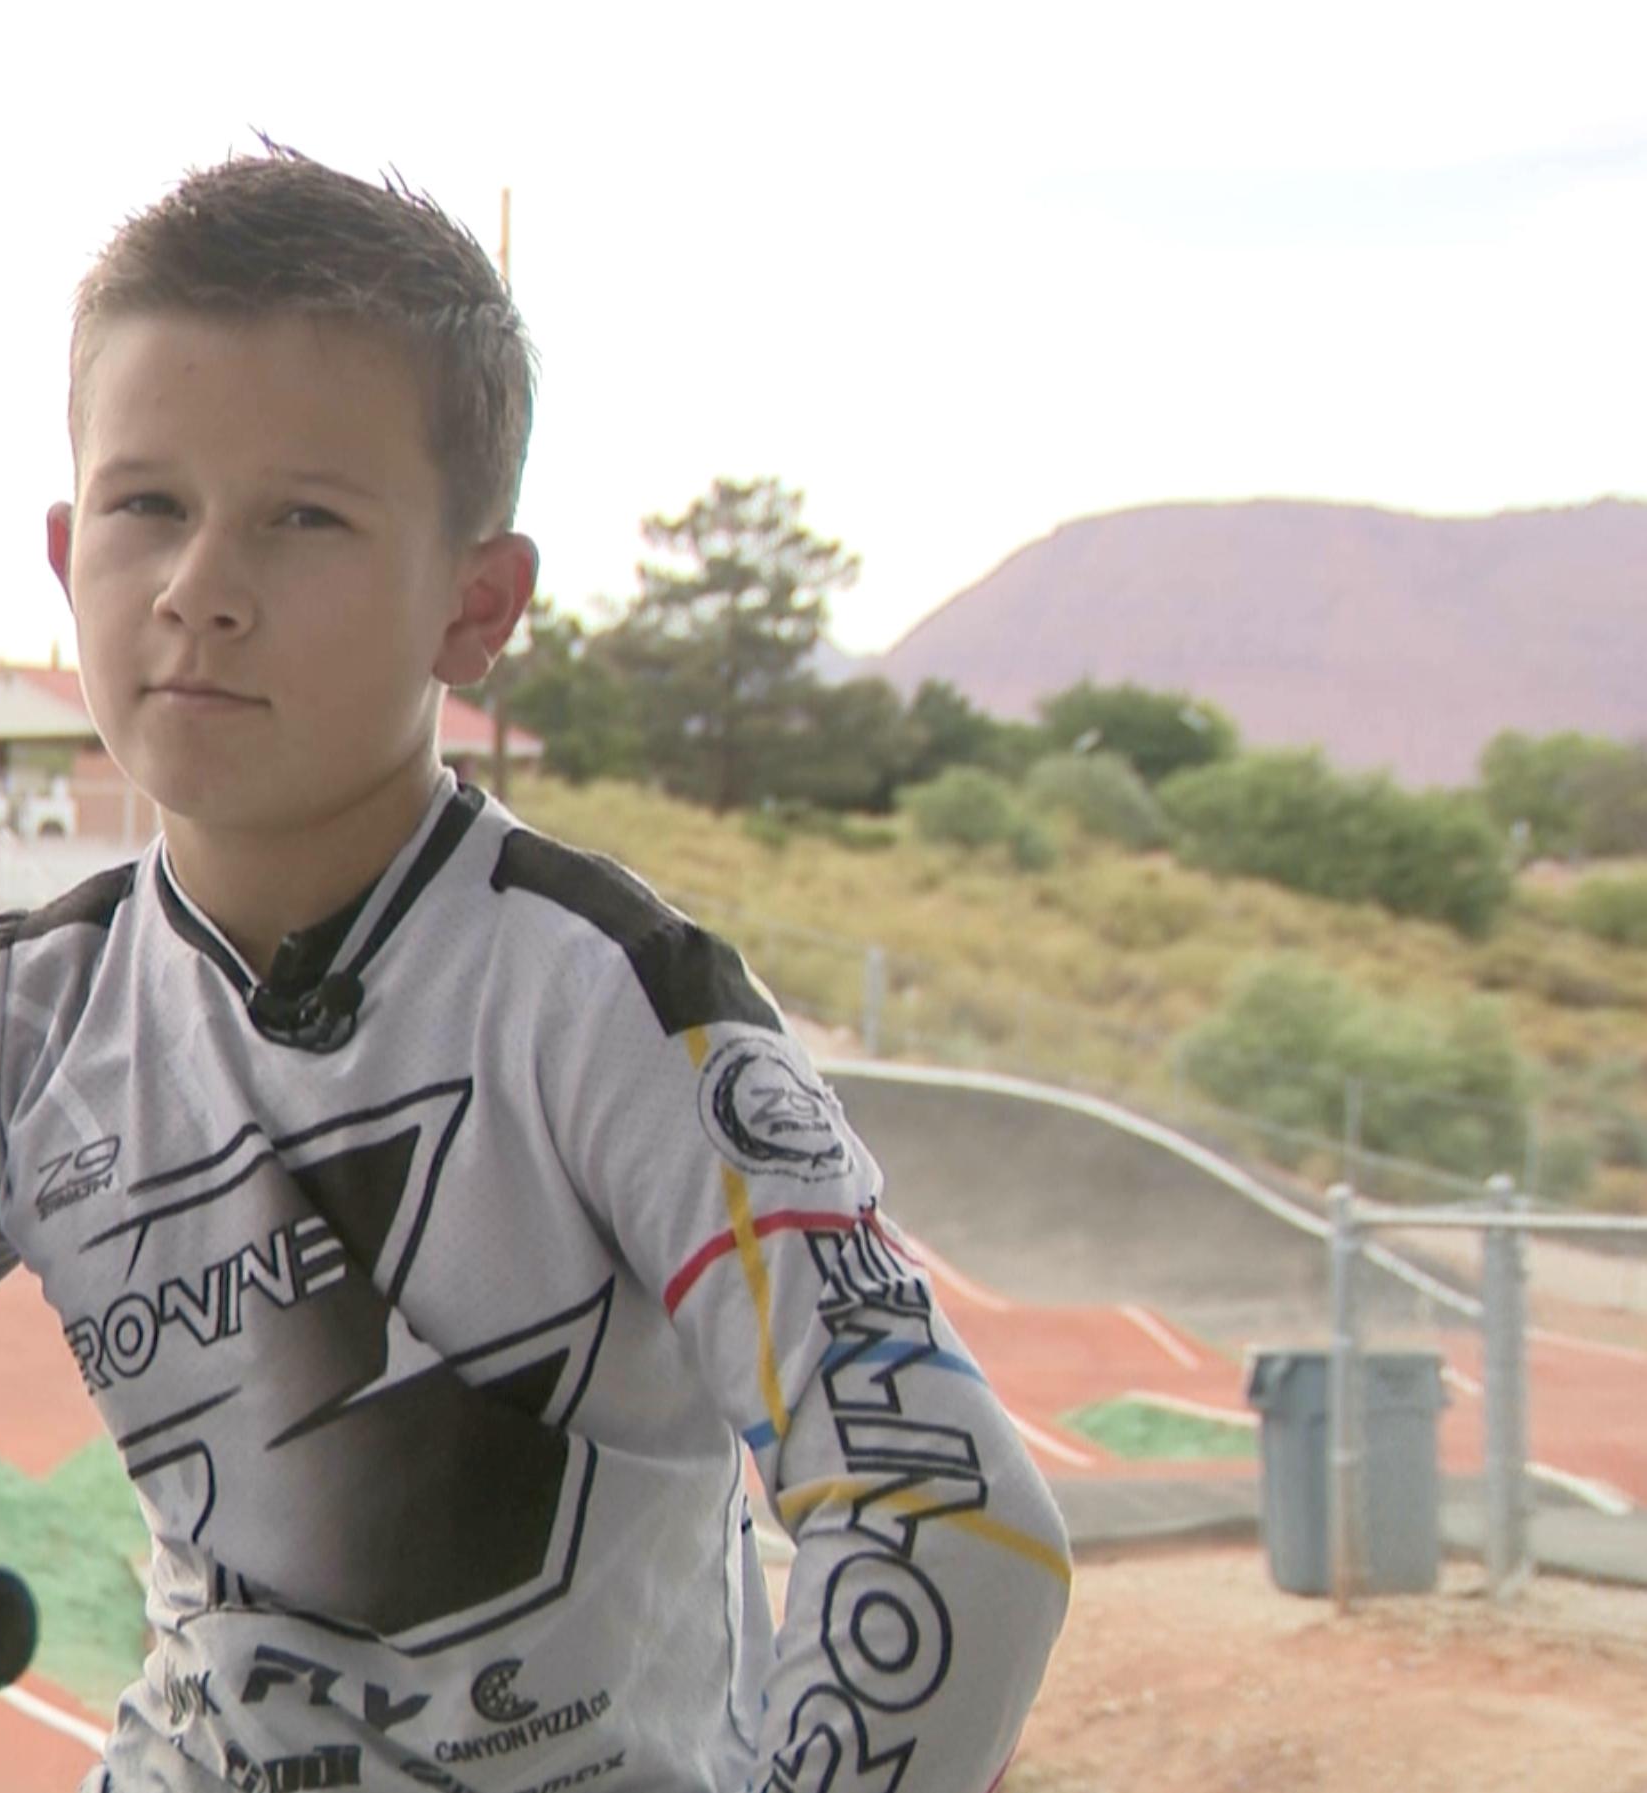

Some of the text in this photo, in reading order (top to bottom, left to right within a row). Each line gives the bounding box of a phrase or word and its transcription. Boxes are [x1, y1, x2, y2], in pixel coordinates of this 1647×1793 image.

[35, 1136, 120, 1206] Z9
[435, 1727, 529, 1763] CANYON
[528, 1700, 592, 1743] PIZZA
